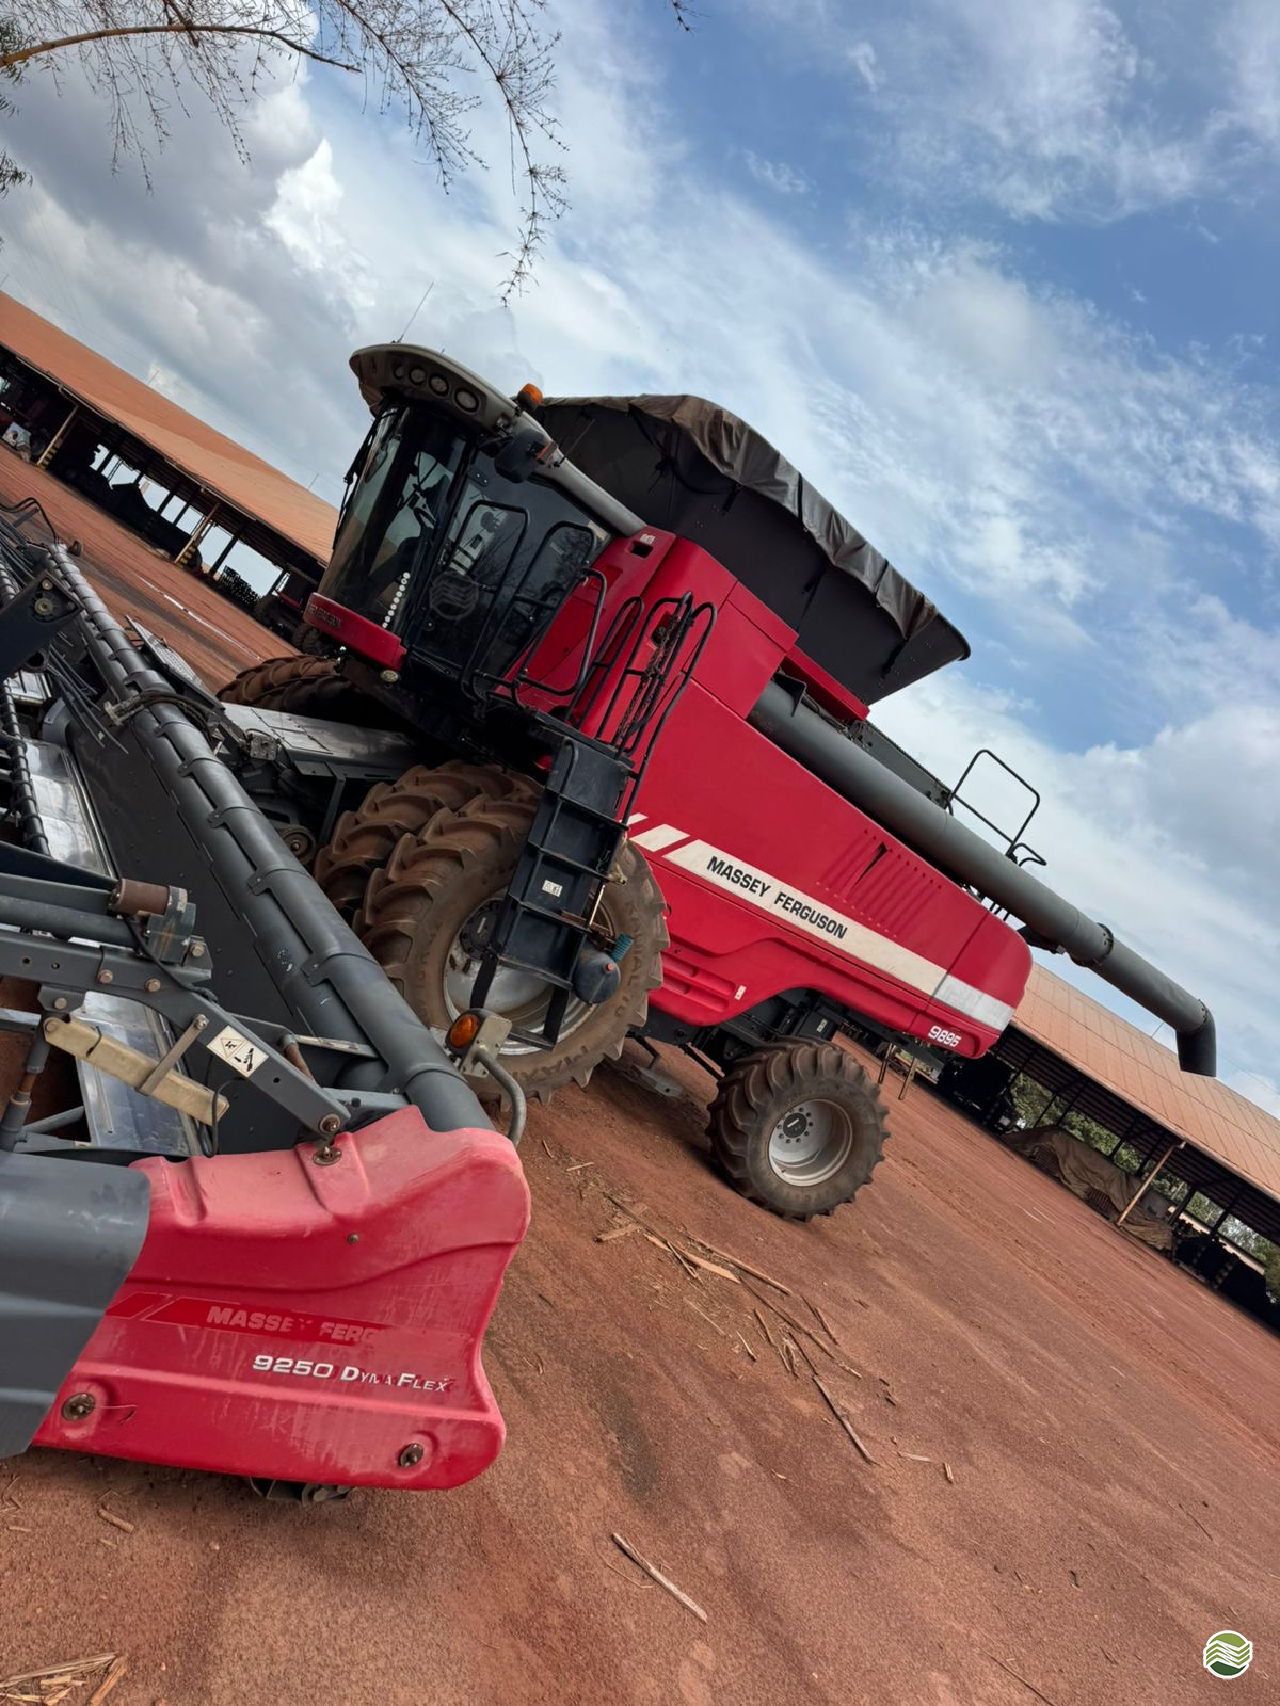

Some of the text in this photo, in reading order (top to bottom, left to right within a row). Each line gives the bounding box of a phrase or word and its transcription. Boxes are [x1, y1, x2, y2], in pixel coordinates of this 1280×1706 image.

[706, 855, 849, 940] MASSEY FERGUSON
[927, 1025, 963, 1048] 9895
[252, 1354, 334, 1379] 9250
